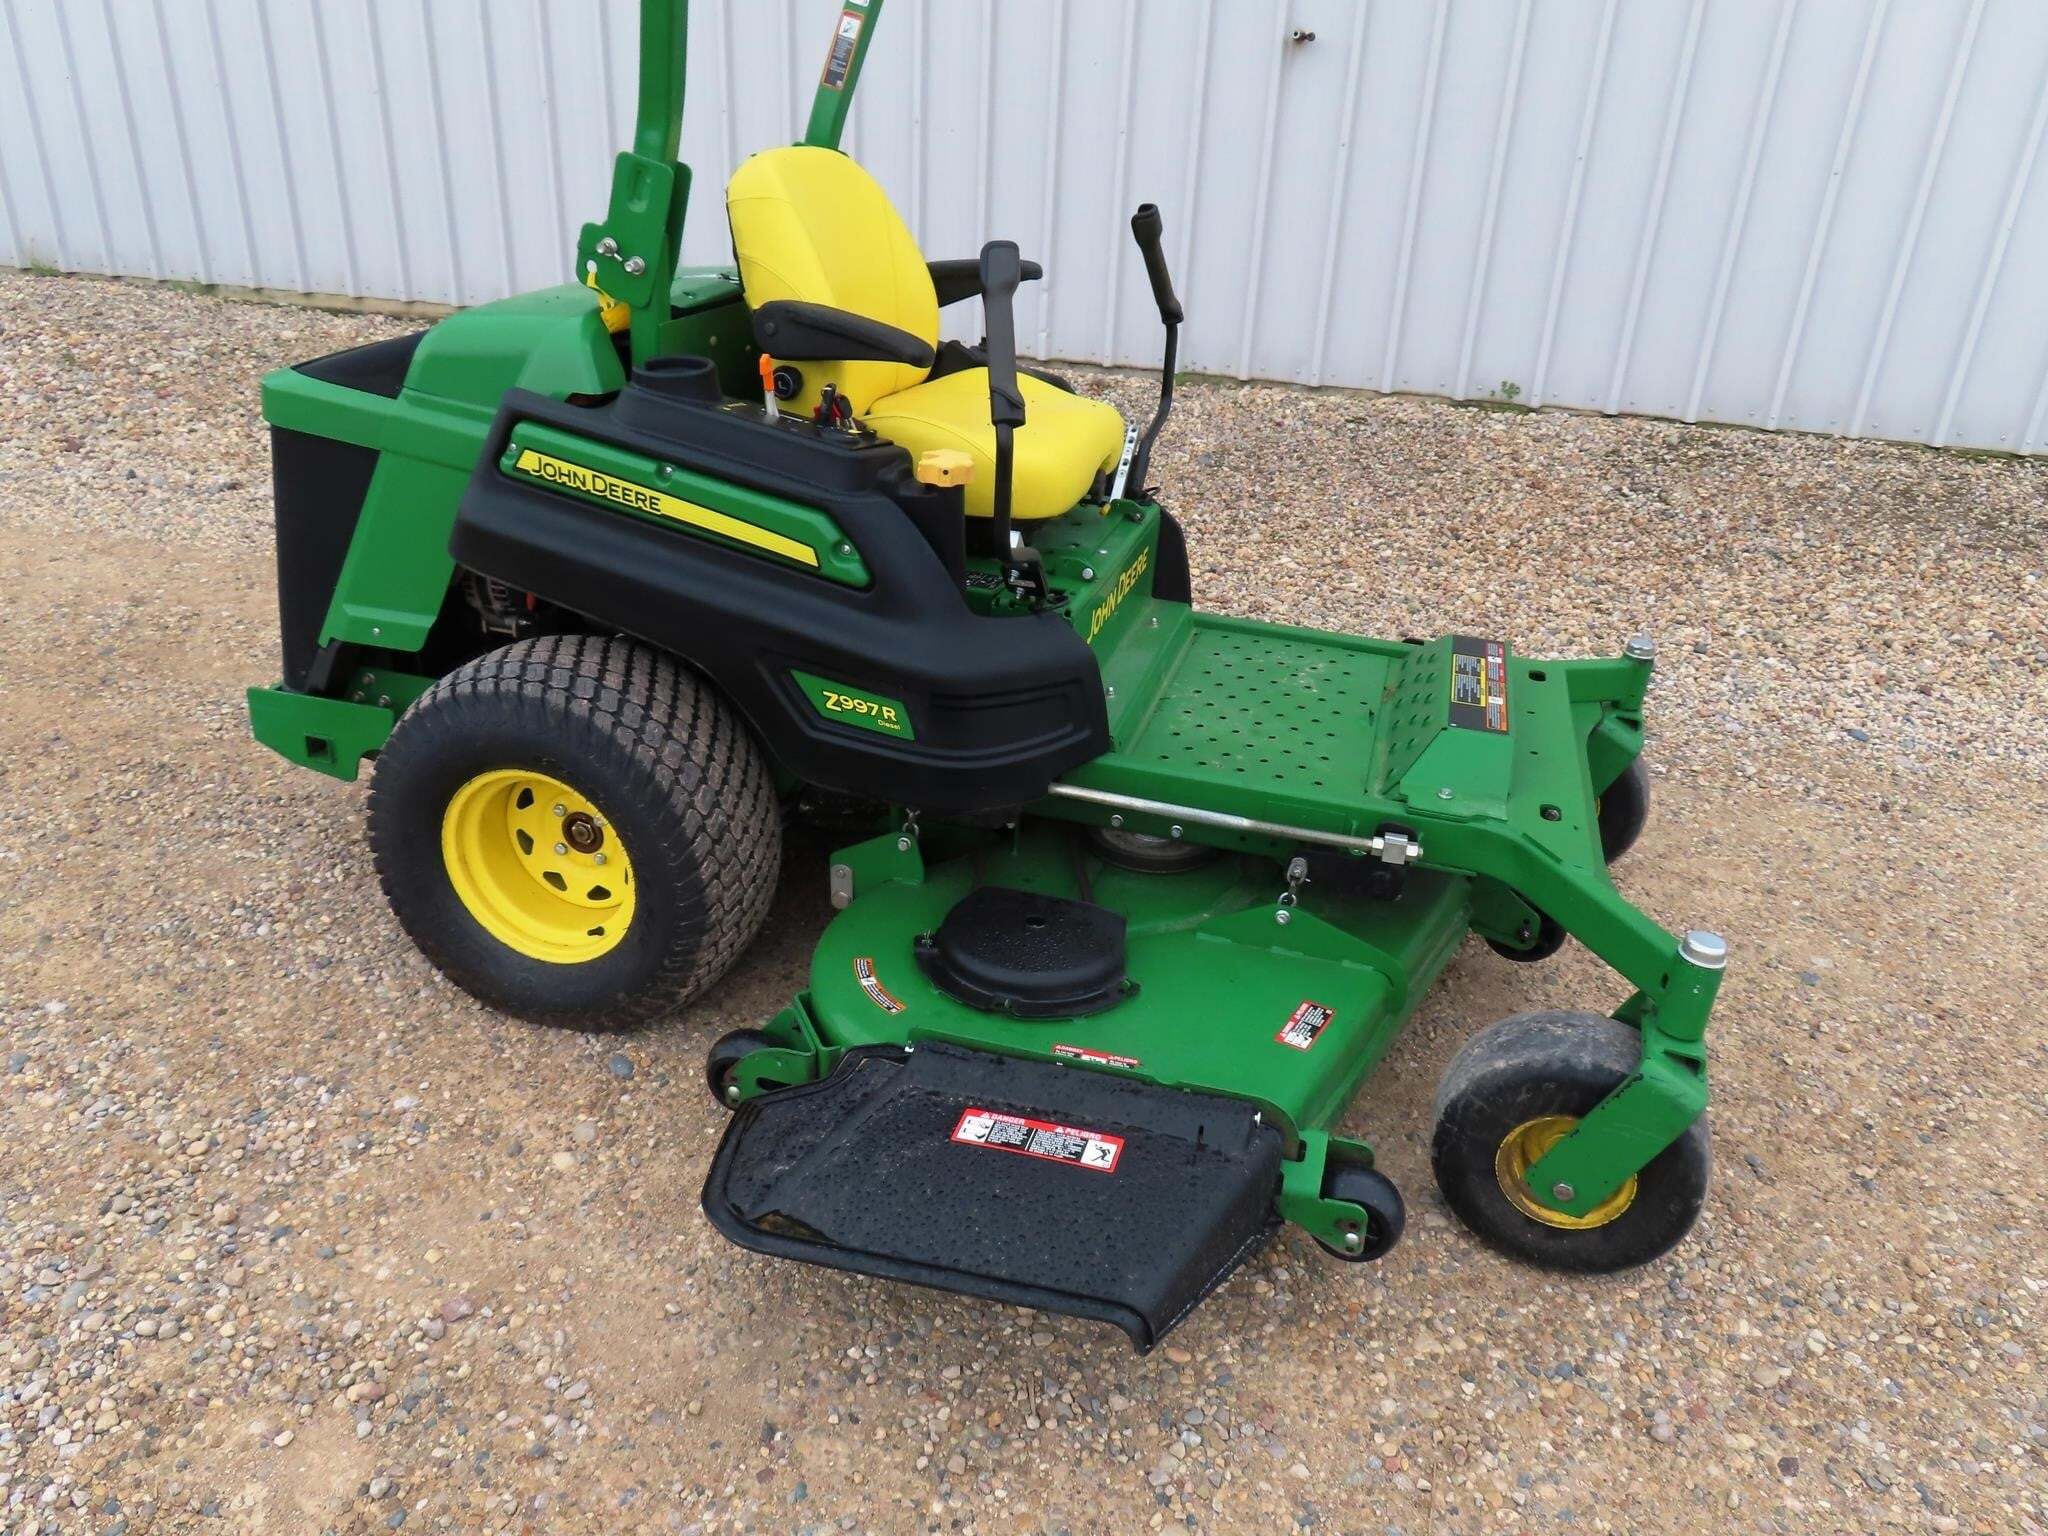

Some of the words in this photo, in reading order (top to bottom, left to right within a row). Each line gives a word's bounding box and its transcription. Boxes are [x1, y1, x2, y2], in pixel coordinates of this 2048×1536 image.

[532, 457, 587, 489] JOHN
[592, 473, 662, 513] DEERE
[1086, 587, 1118, 645] JOHN
[1116, 545, 1149, 605] DEERE
[877, 719, 901, 730] Diesel
[990, 1111, 1025, 1126] DANGER
[1063, 1127, 1102, 1140] PELIGRO
